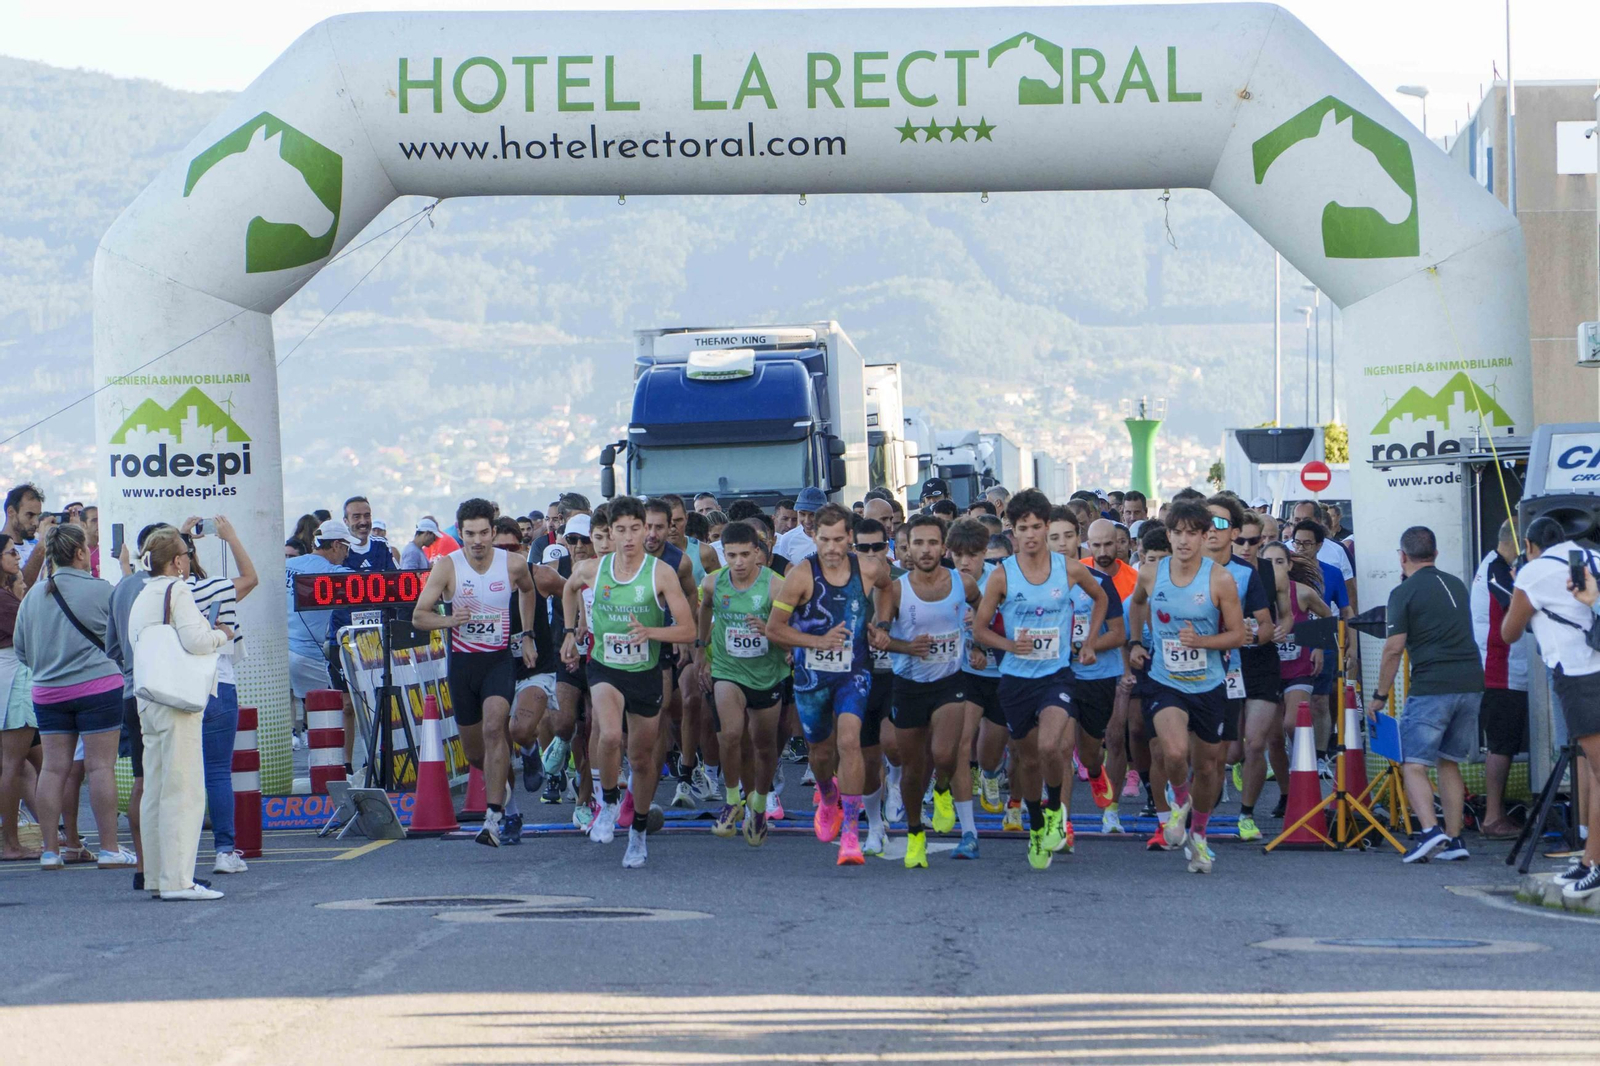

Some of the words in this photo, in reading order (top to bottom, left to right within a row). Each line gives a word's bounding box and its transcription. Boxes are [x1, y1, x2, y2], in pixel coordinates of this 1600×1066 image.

[398, 54, 641, 114] HOTEL
[692, 51, 779, 111] LA
[398, 121, 847, 160] www.hotelrectoral.com
[741, 336, 766, 344] KING
[110, 443, 252, 485] rodespi
[1387, 471, 1462, 488] www.rode
[122, 484, 237, 500] www.rodespi.es
[597, 603, 613, 612] SAN
[614, 604, 650, 613] MIGUEL
[466, 621, 496, 634] 524
[613, 642, 641, 655] 611
[733, 637, 762, 649] 506
[929, 640, 956, 655] 515
[814, 650, 844, 662] 541
[1170, 649, 1200, 662] 510
